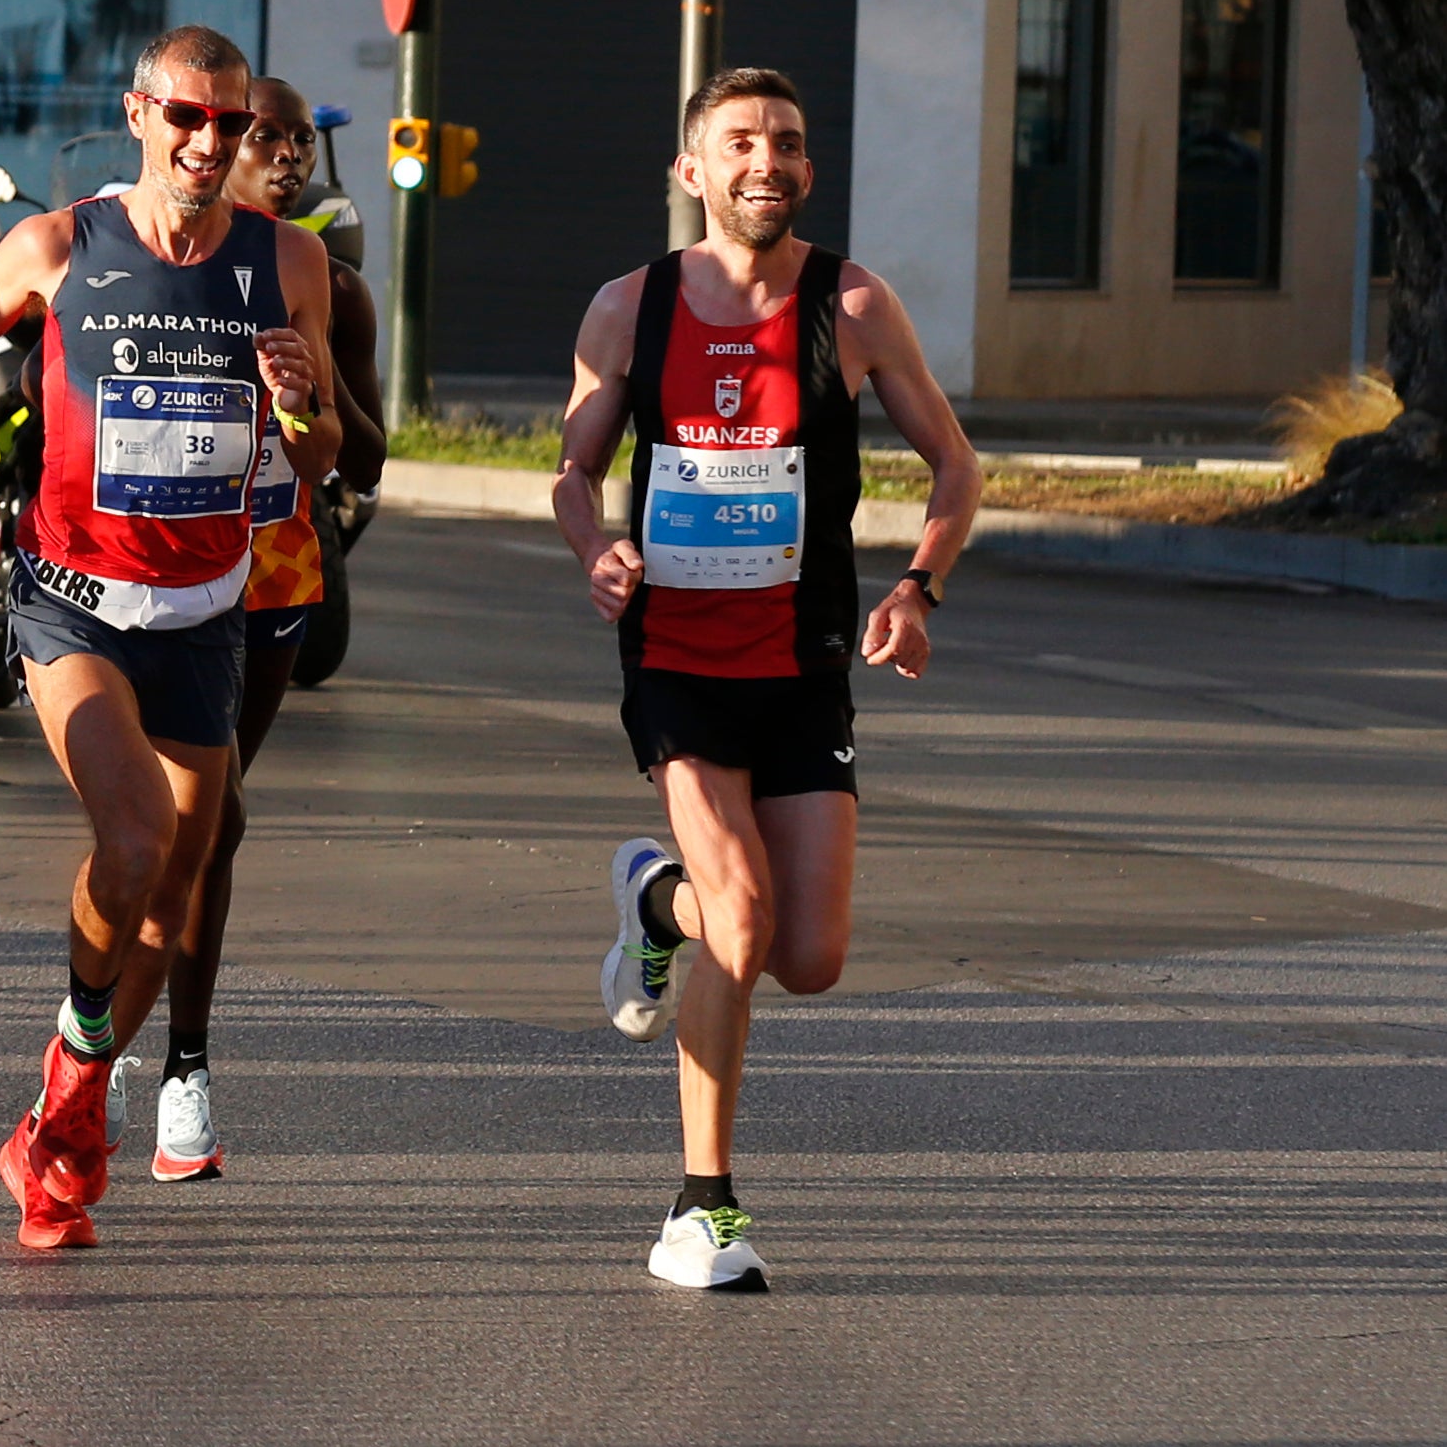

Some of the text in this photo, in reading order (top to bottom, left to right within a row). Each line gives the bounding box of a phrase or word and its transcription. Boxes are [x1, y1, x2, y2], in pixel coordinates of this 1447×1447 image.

[81, 313, 258, 337] A.D.MARATHON
[146, 341, 233, 375] alquiber
[161, 390, 225, 407] ZURICH
[185, 435, 215, 455] 38
[676, 424, 780, 446] SUANZES
[705, 464, 770, 479] ZURICH
[713, 503, 778, 524] 4510
